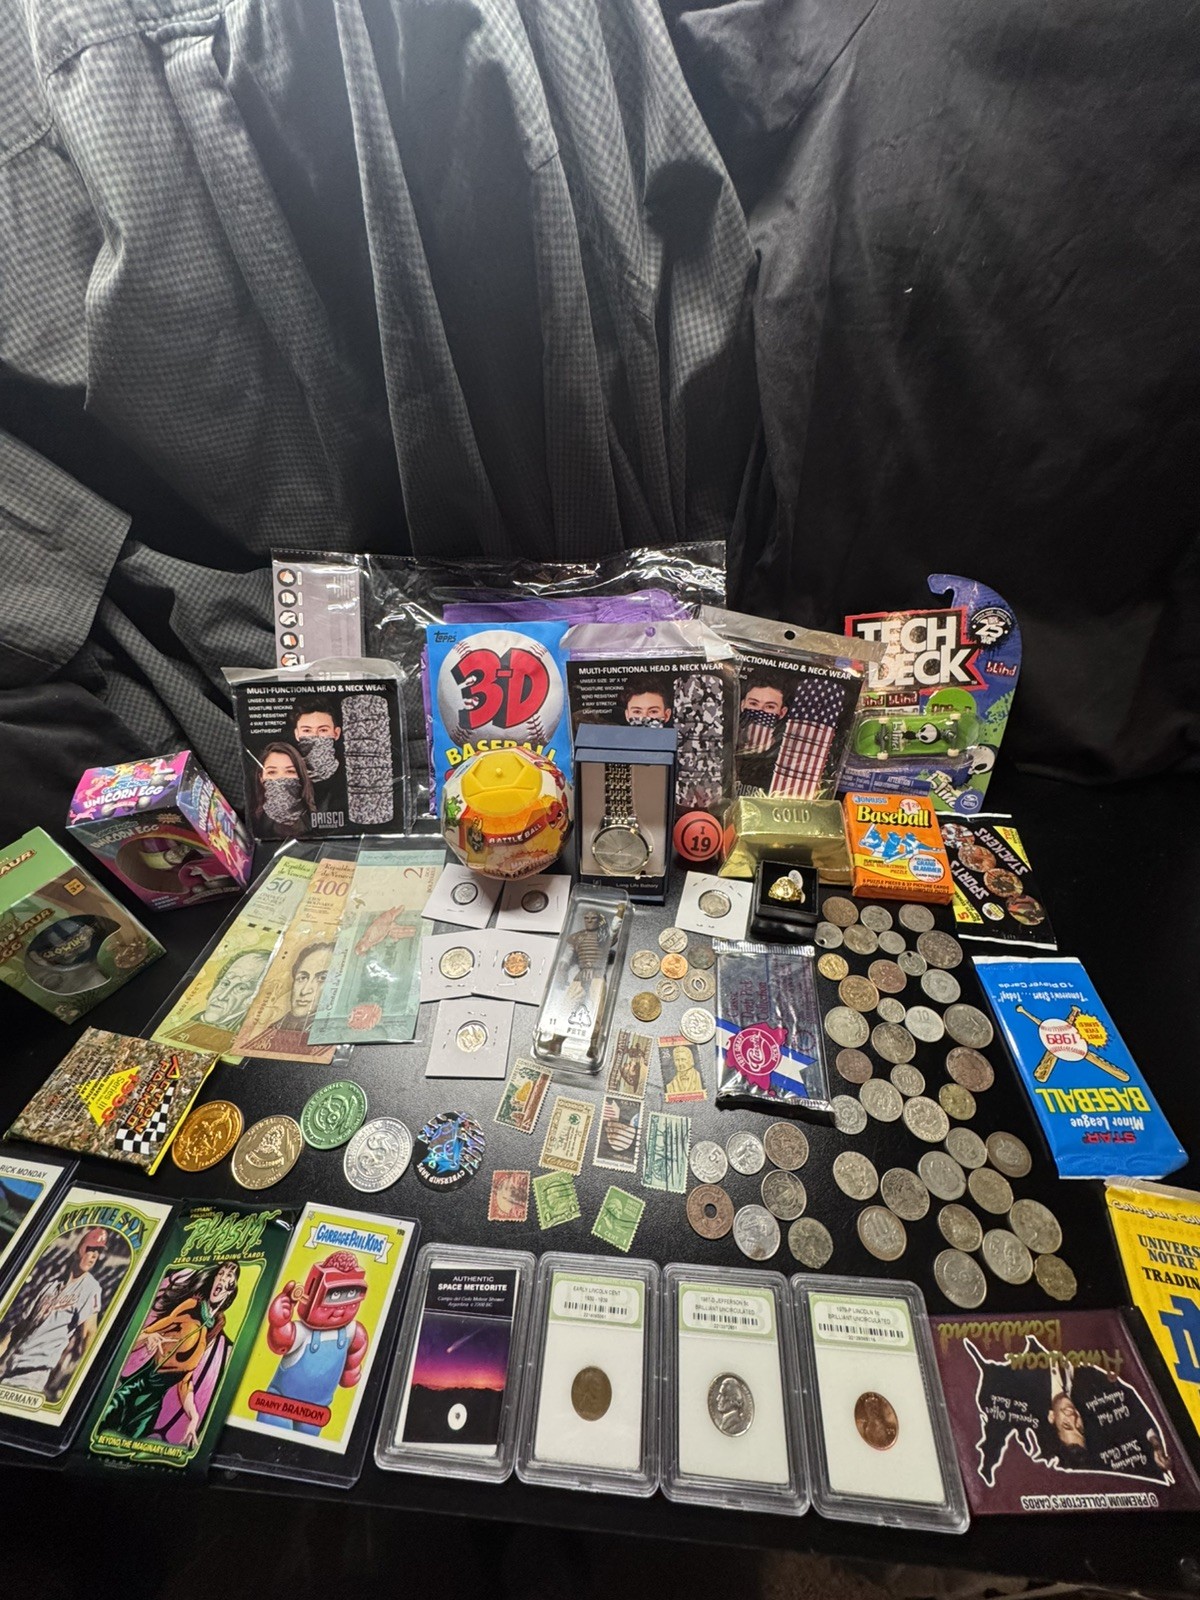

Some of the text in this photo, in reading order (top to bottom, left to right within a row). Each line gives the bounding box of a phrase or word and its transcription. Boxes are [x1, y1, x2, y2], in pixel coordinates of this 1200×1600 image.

[857, 616, 957, 653] TECH
[579, 665, 648, 674] MULTI-FUNCTIONAL
[680, 663, 699, 671] NECK
[778, 662, 799, 671] HEAD
[808, 667, 828, 676] NECK
[829, 671, 851, 680] WEAR
[868, 644, 972, 688] DECK
[246, 686, 316, 694] MULTI-FUNCTIONAL
[317, 685, 337, 693] HEAD
[345, 684, 364, 692] NECK
[450, 647, 550, 730] 3-D
[83, 786, 138, 808] UNICORN
[138, 785, 164, 796] EGG
[311, 811, 344, 827] BRISCO
[772, 807, 812, 823] GOLD
[857, 805, 930, 826] Baseball
[89, 830, 136, 849] UNICORN
[137, 824, 160, 835] EGG
[489, 824, 542, 844] BATTLE BALL
[690, 836, 711, 852] 19
[974, 827, 1028, 876] STACKERS
[403, 867, 423, 879] 2
[950, 860, 990, 900] SPORTS
[266, 878, 294, 894] 50
[312, 879, 349, 897] 100
[916, 1009, 930, 1022] 10
[1046, 1032, 1077, 1045] 1989
[746, 1031, 766, 1072] Classic
[771, 1044, 779, 1063] PICKS
[97, 1076, 125, 1111] Series III
[100, 1073, 140, 1126] 1993
[125, 1060, 169, 1128] PACKED
[135, 1055, 181, 1134] ACTION
[1034, 1087, 1151, 1113] BASEBALL
[1070, 1114, 1145, 1131] Minor League
[1082, 1130, 1137, 1145] STAR
[0, 1163, 48, 1179] RICK MONDAY
[429, 1170, 466, 1185] CYBERSHIP
[59, 1206, 148, 1244] WHITE SOX
[183, 1209, 281, 1256] PLASM
[316, 1224, 384, 1252] GARBAGE PAIL KIDS
[603, 1230, 619, 1242] CENT
[1137, 1234, 1200, 1258] UNIVERS
[173, 1251, 266, 1264] ZERO ISSUE TRADING CARDS
[1147, 1248, 1198, 1271] NOTRE
[438, 1283, 462, 1291] SPACE
[1141, 1266, 1200, 1291] TRADIN
[590, 1287, 608, 1295] LINCOLN
[695, 1304, 756, 1316] BRILLIANT UNCIRCULATED
[715, 1297, 743, 1306] JEFFERSON
[827, 1313, 891, 1325] BRILLIANT UNCIRCULATED
[853, 1308, 874, 1316] LINCOLN
[937, 1319, 1061, 1358] Bandstand
[1007, 1349, 1124, 1382] American
[0, 1390, 39, 1406] ERRMANN
[989, 1394, 1028, 1413] See Back
[1085, 1389, 1125, 1409] Autographs
[255, 1397, 325, 1421] BRAINY BRANDON
[984, 1405, 1040, 1429] Special Offer
[1113, 1404, 1130, 1421] Gold
[98, 1434, 184, 1458] BEYOND THE IMAGINARY LIMITS
[1099, 1439, 1140, 1461] Dick Clark
[1110, 1452, 1147, 1471] Featuring
[1021, 1493, 1159, 1510] 8 PREMIUM COLLECTOR'S CARDS
